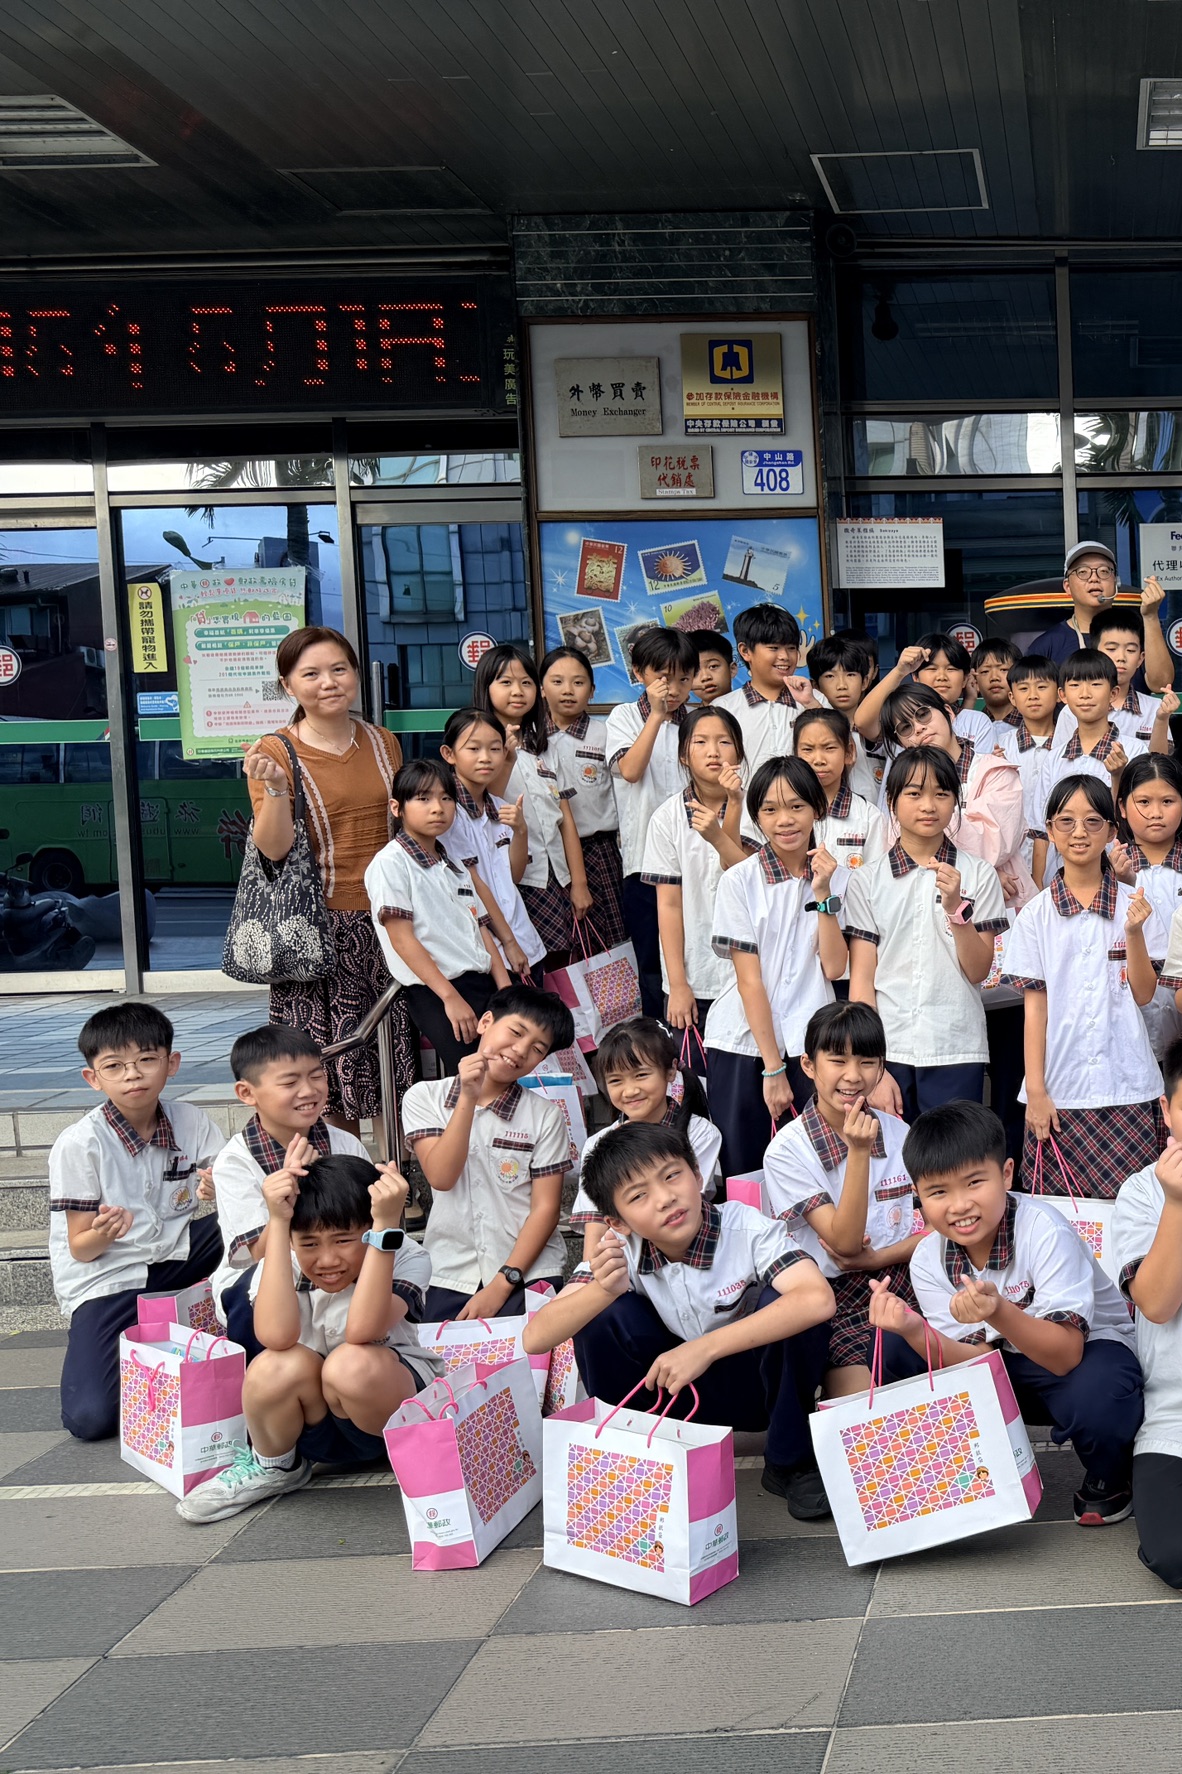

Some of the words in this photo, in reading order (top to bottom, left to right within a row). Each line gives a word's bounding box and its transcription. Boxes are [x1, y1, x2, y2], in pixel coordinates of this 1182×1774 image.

[569, 382, 647, 401] 外幣買賣
[686, 391, 779, 401] 參加存款保險金融機構
[570, 408, 598, 418] Money
[603, 407, 647, 418] Exchanger
[763, 452, 795, 462] 中山路
[657, 472, 696, 488] 代銷處
[754, 468, 790, 492] 408
[614, 545, 624, 555] 12
[648, 579, 660, 591] 12
[772, 583, 780, 592] 5
[664, 604, 672, 613] 10
[138, 601, 158, 670] 請勿攜帶寵物進入
